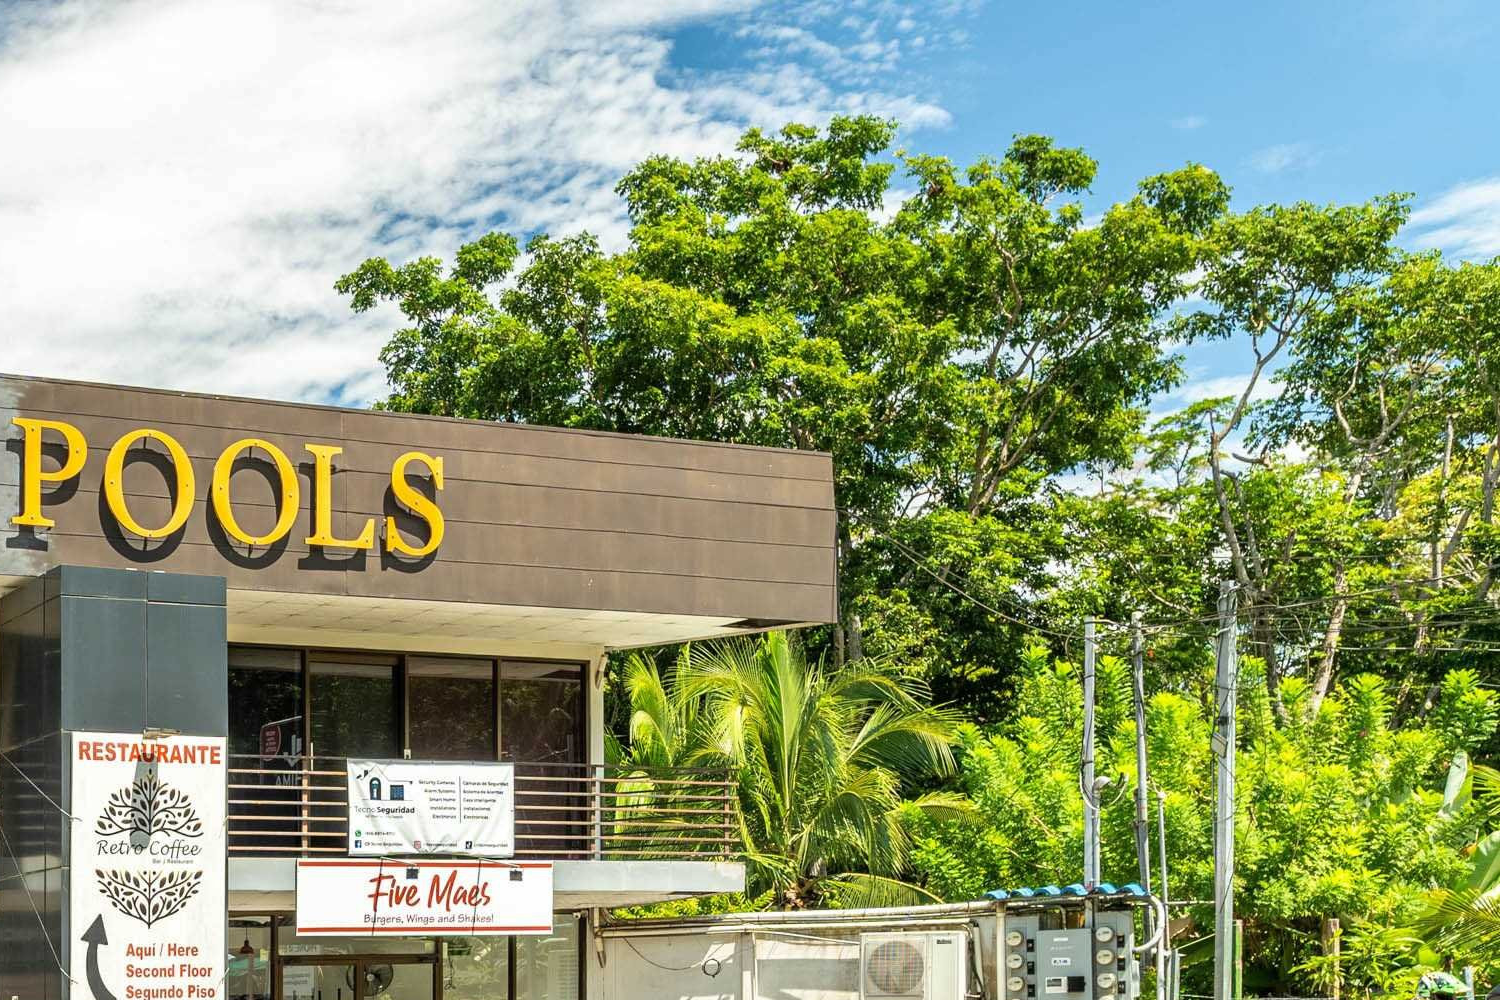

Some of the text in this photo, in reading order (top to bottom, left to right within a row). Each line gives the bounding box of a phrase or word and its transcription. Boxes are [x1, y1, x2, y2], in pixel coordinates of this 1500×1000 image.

[11, 417, 444, 556] POOLS
[78, 740, 221, 765] RESTAURANTE
[377, 806, 415, 814] Seguridad
[97, 839, 203, 859] Retro Coffee
[368, 870, 491, 912] Five Maes
[364, 914, 494, 924] Burgers, Wings and Shakes!
[167, 943, 199, 956] Here
[126, 964, 213, 978] Second Floor
[187, 985, 216, 998] Piso
